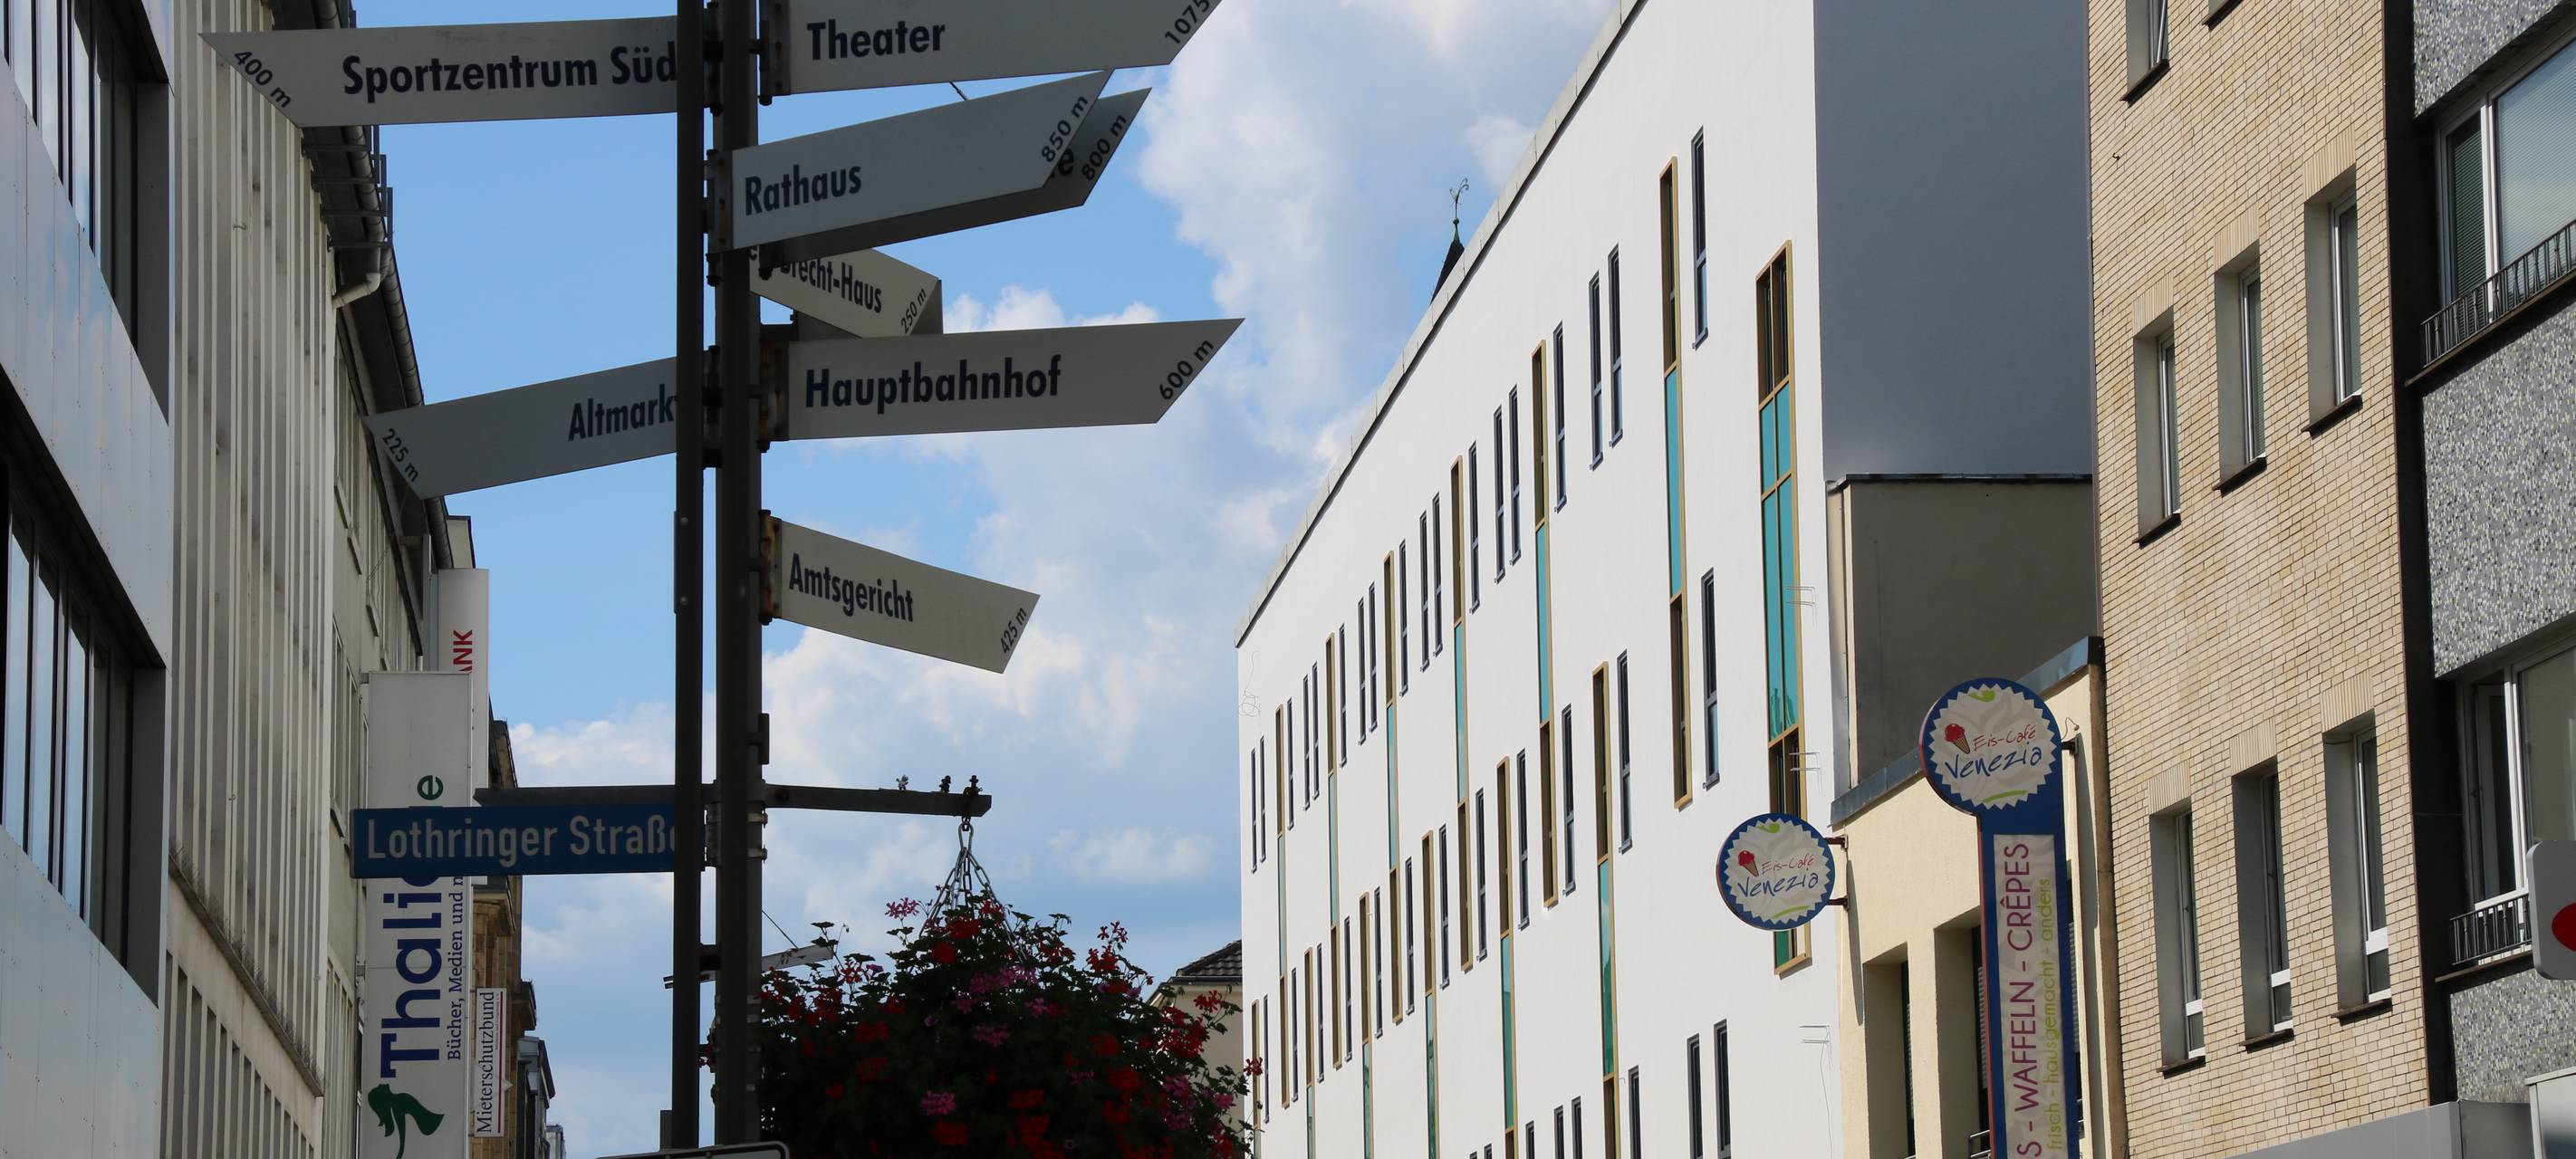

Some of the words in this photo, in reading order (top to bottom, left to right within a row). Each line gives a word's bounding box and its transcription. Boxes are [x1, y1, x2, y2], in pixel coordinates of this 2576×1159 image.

[806, 19, 946, 61] Theater
[1165, 0, 1209, 43] 1075
[233, 49, 273, 87] 400
[270, 86, 293, 109] m
[342, 55, 598, 103] Sportzentrum
[610, 41, 677, 85] Süd
[1042, 120, 1072, 163] 850
[1071, 96, 1089, 119] m
[1081, 139, 1110, 181] 800
[1110, 115, 1127, 137] m
[745, 164, 861, 216] Rathaus
[901, 301, 918, 334] 250
[918, 288, 927, 306] m
[805, 354, 1062, 415] Hauptbahnhof
[1158, 359, 1195, 401] 600
[1193, 339, 1215, 361] m
[567, 383, 677, 442] Altmark
[382, 427, 409, 463] 225
[404, 463, 418, 483] m
[789, 553, 914, 622] Amtsgericht
[1001, 623, 1018, 656] 425
[1016, 607, 1027, 626] m
[1944, 741, 2043, 780] Venezia
[1973, 724, 2037, 752] Eis-Café
[368, 818, 558, 867] Lothringer
[1761, 853, 1815, 876] Eis-Café
[448, 892, 463, 924] und
[1737, 867, 1819, 898] Venezia
[2000, 843, 2033, 951] CRÊPES
[2036, 878, 2054, 942] anders
[380, 874, 442, 1078] Thali
[448, 930, 463, 993] Medien
[447, 998, 466, 1060] Bücher,
[2009, 981, 2040, 1113] WAFFELN
[2038, 960, 2059, 1084] hausgemacht
[476, 991, 495, 1135] Mieterschutzbund
[2043, 1103, 2062, 1150] frisch
